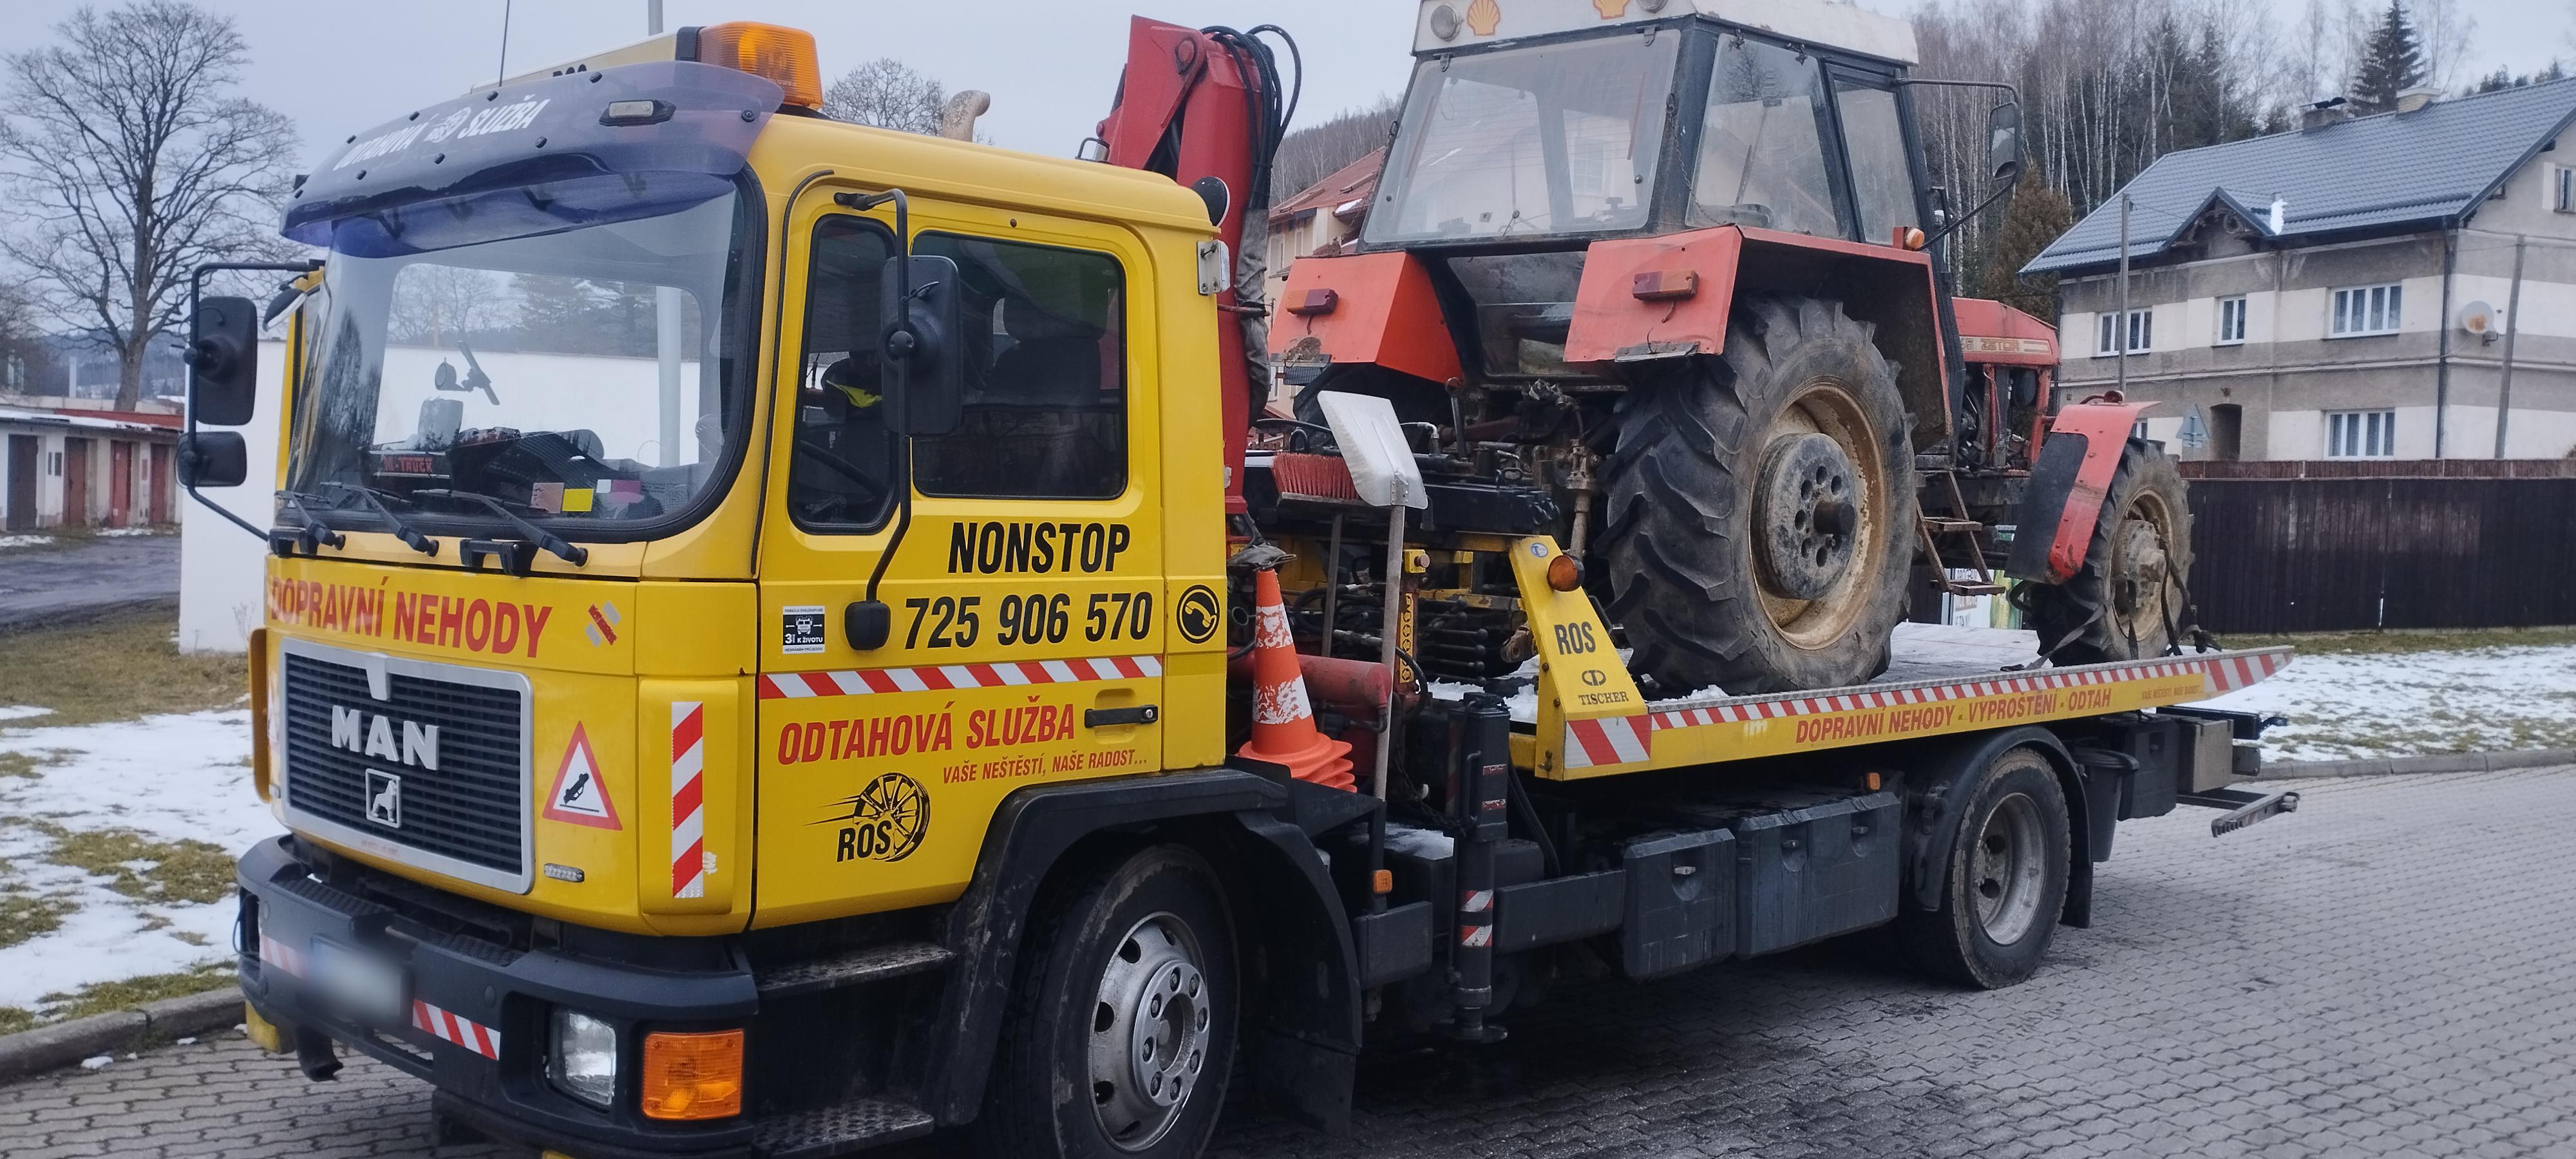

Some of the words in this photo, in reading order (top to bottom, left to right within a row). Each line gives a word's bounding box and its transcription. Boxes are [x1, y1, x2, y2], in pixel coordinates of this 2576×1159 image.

[457, 94, 551, 139] SLUŽBA
[1981, 339, 2019, 351] ZETOR
[948, 522, 1130, 574] NONSTOP
[270, 576, 389, 637] DOPRAVNÍ
[393, 592, 553, 658] NEHODY
[905, 596, 981, 649] 725
[998, 593, 1070, 646] 906
[1085, 592, 1152, 642] 570
[1554, 621, 1596, 655] ROS
[1578, 692, 1629, 705] TISCHER
[1795, 706, 1886, 743] DOPRAVNÍ
[1888, 705, 1955, 733] NEHODY
[1969, 690, 2058, 723] VYPROŠTĚNÍ
[2069, 688, 2112, 711] ODTAH
[331, 705, 440, 771] MAN
[777, 701, 955, 765] ODTAHOVÁ
[966, 695, 1074, 749] SLUŽBA
[943, 760, 977, 784] VAŠE
[982, 753, 1046, 780] NEŠTĚSTÍ,
[1052, 749, 1084, 773] NAŠE
[1088, 749, 1147, 769] RADOST...
[837, 820, 892, 862] ROS
